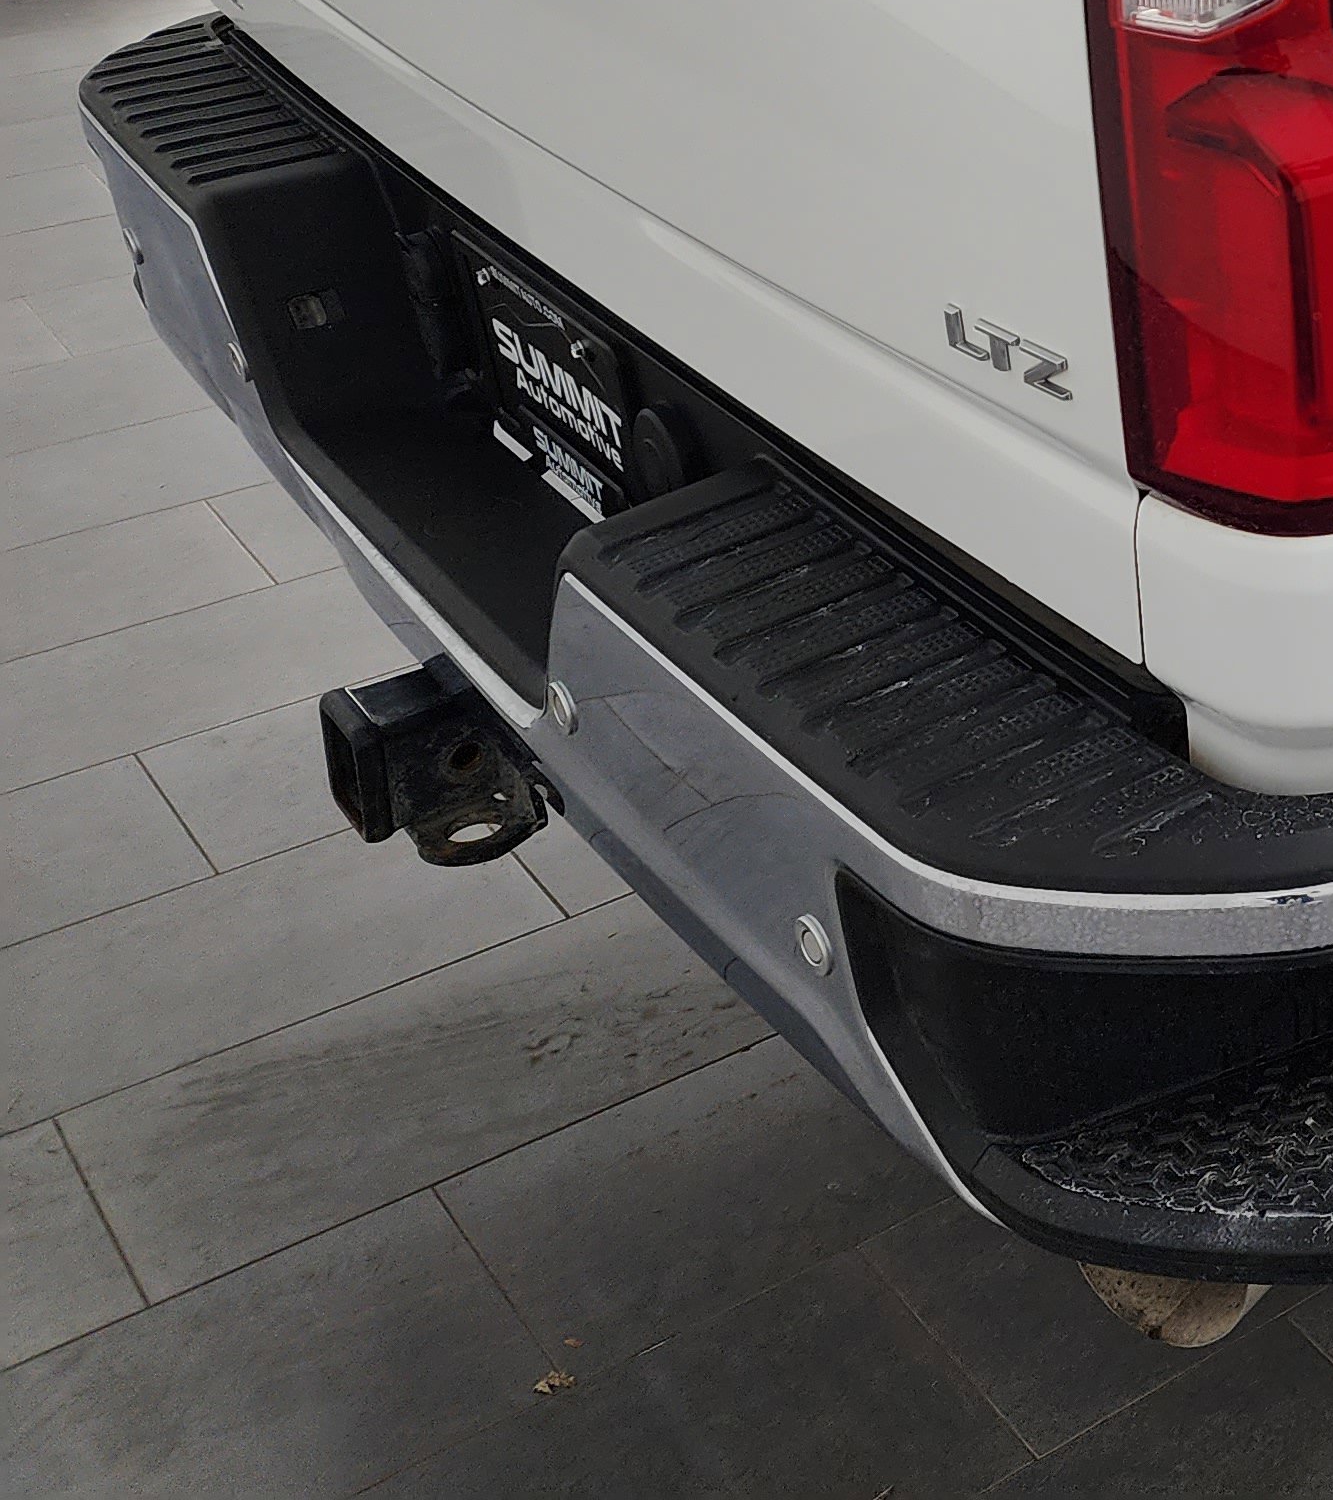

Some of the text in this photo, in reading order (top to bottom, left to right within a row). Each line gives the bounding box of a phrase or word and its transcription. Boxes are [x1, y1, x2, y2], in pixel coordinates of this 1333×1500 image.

[491, 316, 623, 450] SUMMIT
[944, 303, 1073, 401] LTZ
[515, 366, 626, 473] Automotive
[532, 425, 604, 502] SUMMIT
